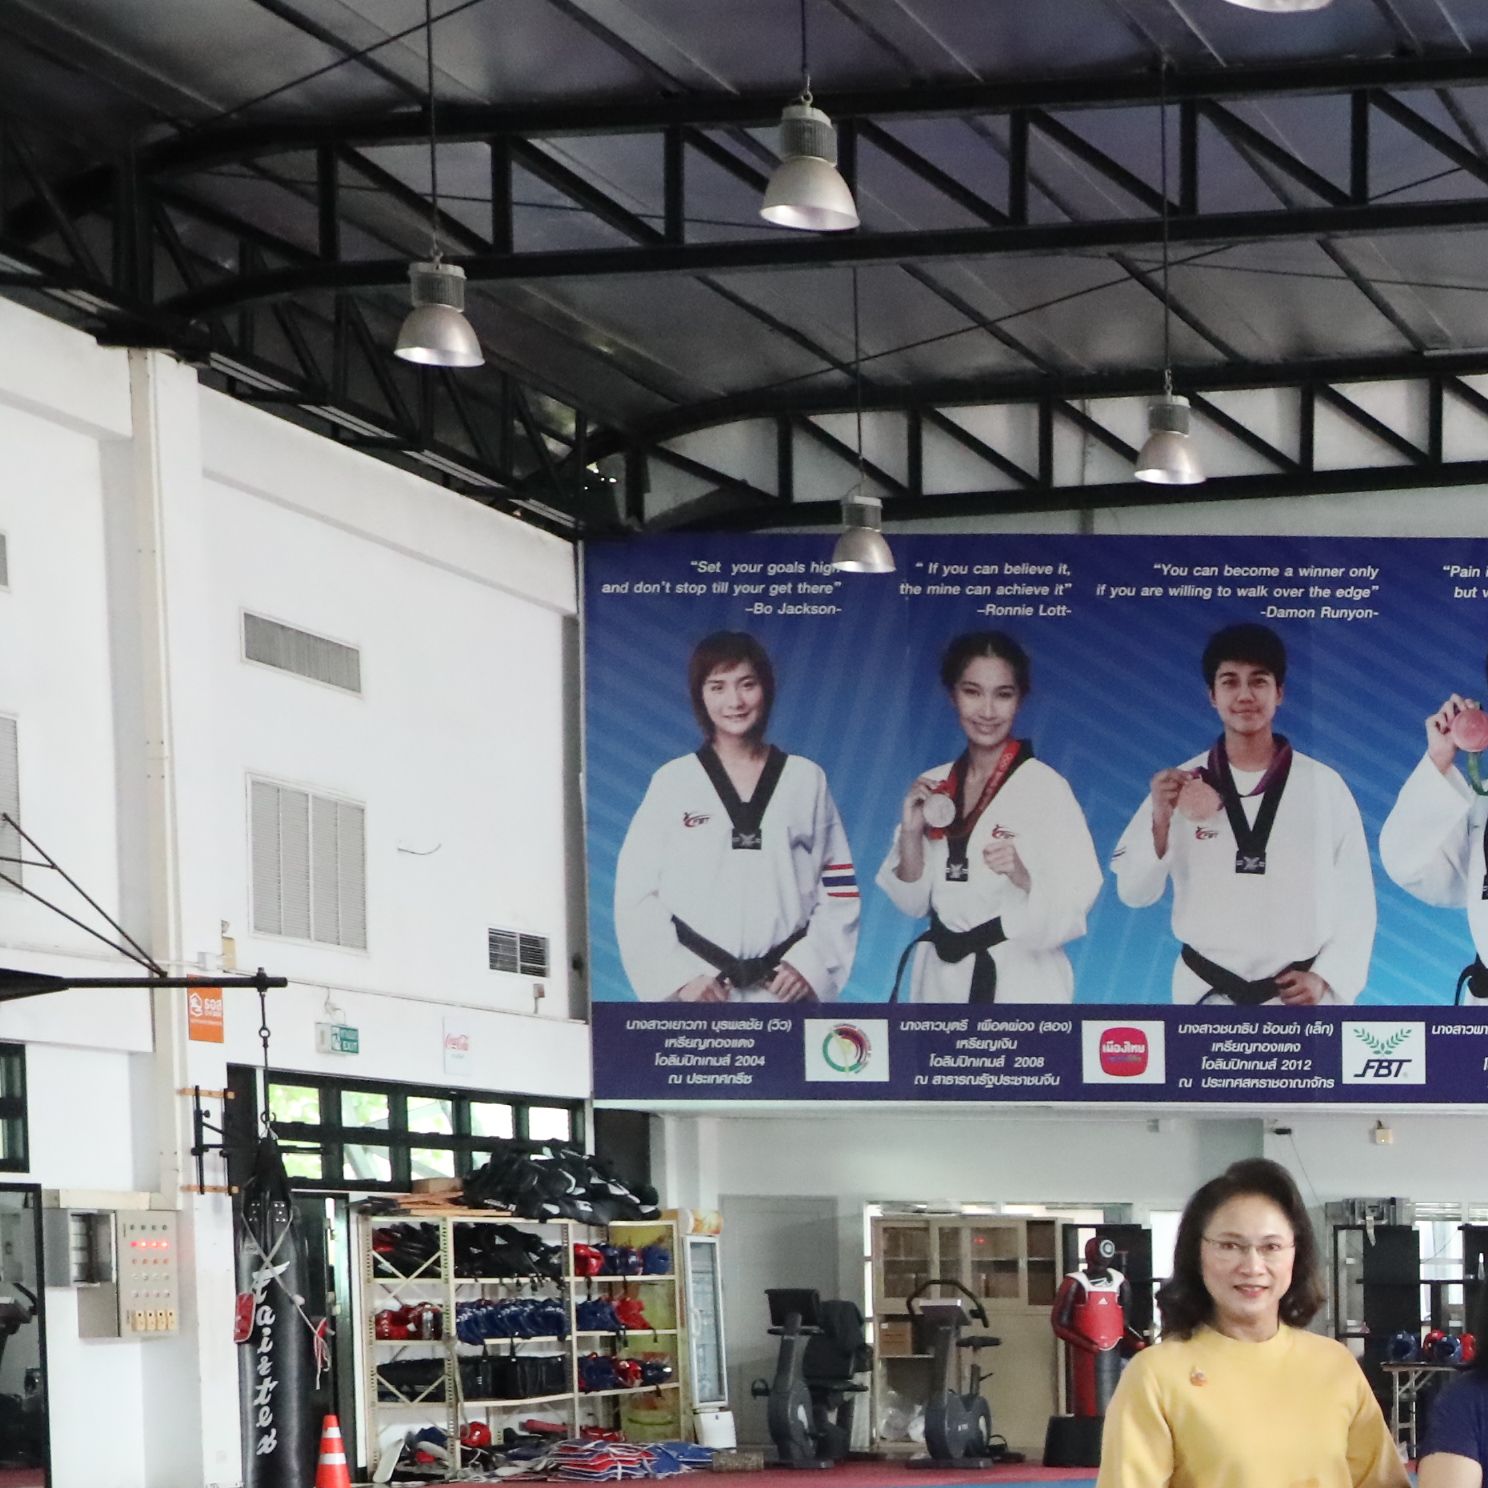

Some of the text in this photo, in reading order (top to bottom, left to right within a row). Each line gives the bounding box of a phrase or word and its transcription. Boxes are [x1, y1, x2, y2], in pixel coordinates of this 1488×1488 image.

[690, 561, 721, 573] “Set
[731, 563, 763, 576] your
[767, 561, 805, 576] goals
[1154, 564, 1379, 580] “You can become a winner only
[1443, 565, 1480, 578] “Pain
[601, 581, 842, 596] and don’t stop till your get there”
[1096, 584, 1379, 600] if you are willing to walk over the edge”
[1454, 586, 1478, 598] but
[745, 602, 842, 615] –Bo Jackson-
[1260, 606, 1379, 621] -Damon Runyon-
[1211, 1040, 1301, 1054] เหรียญทองแดง
[1201, 1056, 1312, 1070] โอลิมปิกเกมส์ 2012
[1354, 1058, 1413, 1078] FBT
[1178, 1078, 1193, 1088] ณ
